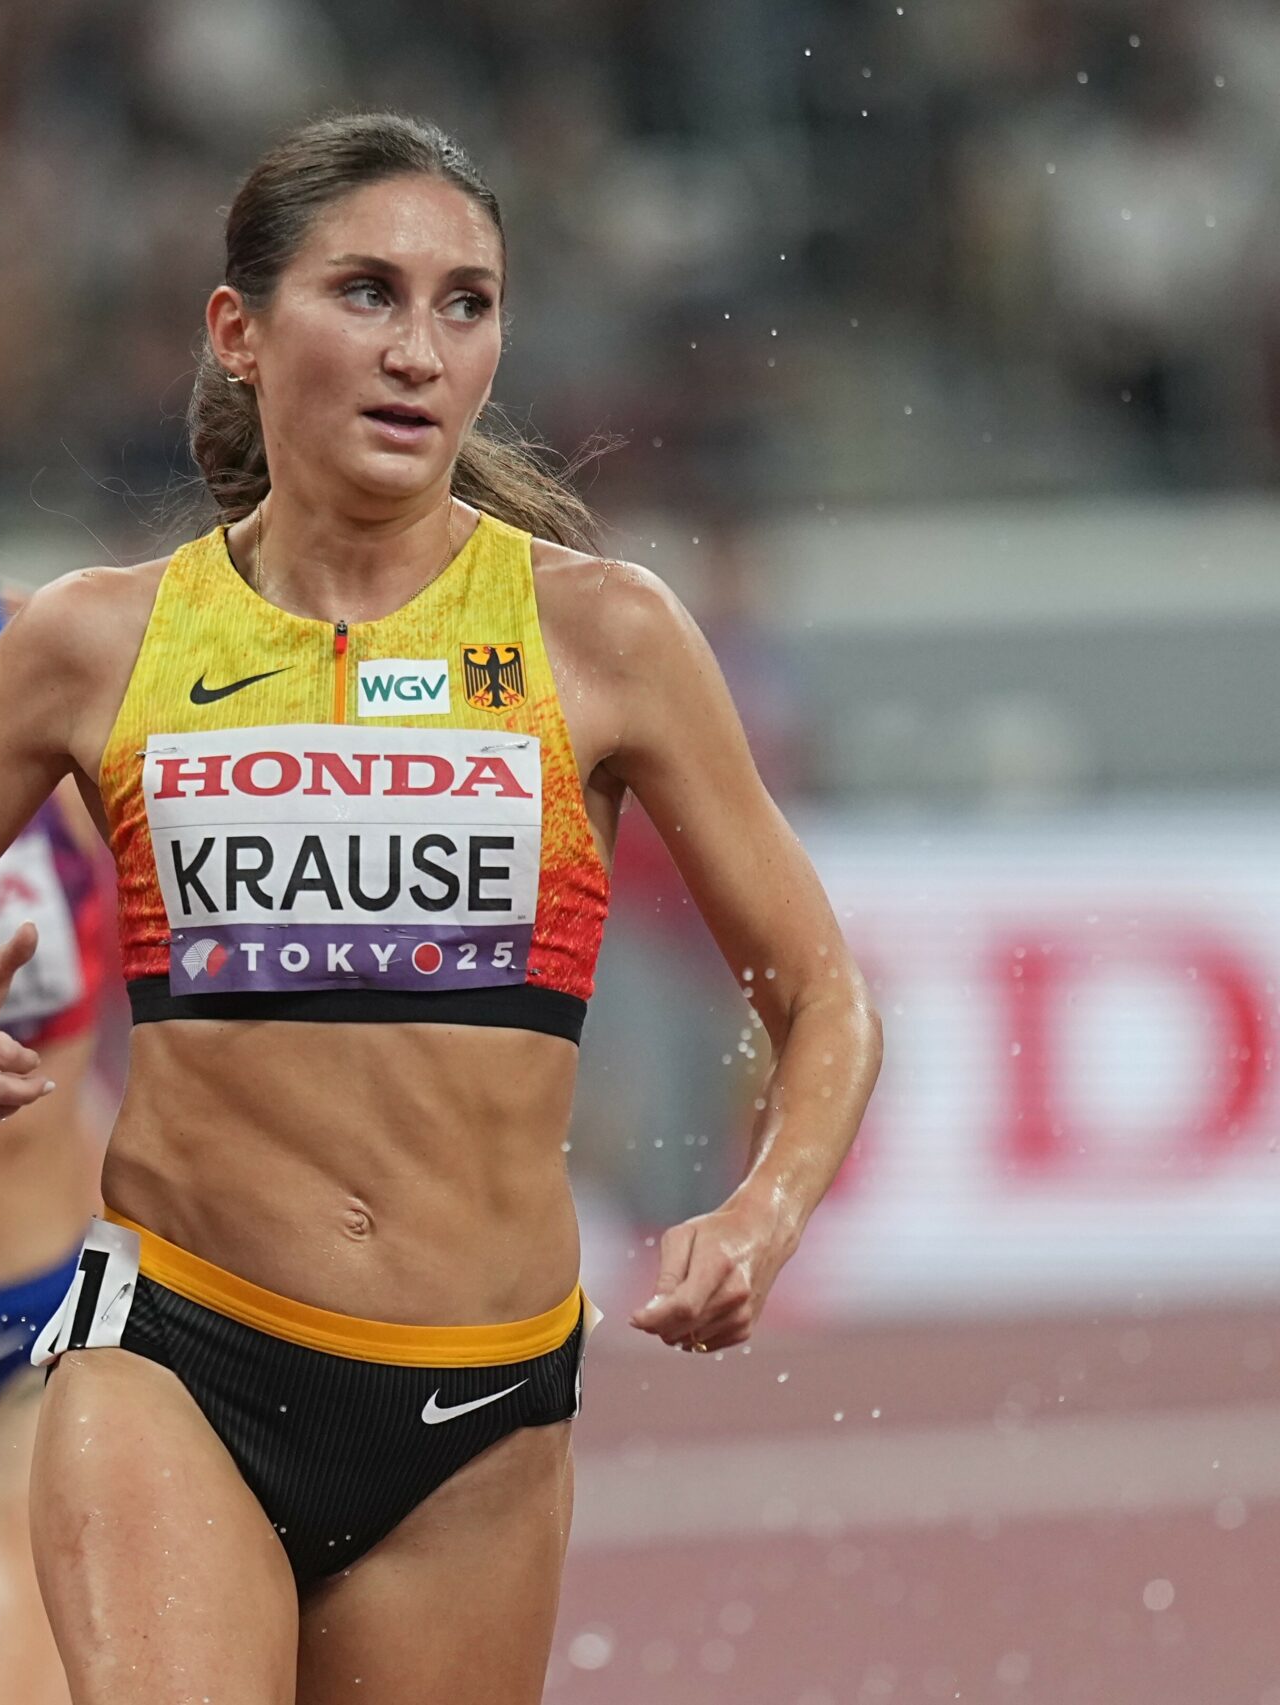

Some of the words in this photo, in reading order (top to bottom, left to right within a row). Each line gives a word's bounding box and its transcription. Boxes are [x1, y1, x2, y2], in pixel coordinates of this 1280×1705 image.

[361, 674, 447, 702] WGV
[153, 751, 533, 800] HONDA
[171, 833, 515, 916] KRAUSE
